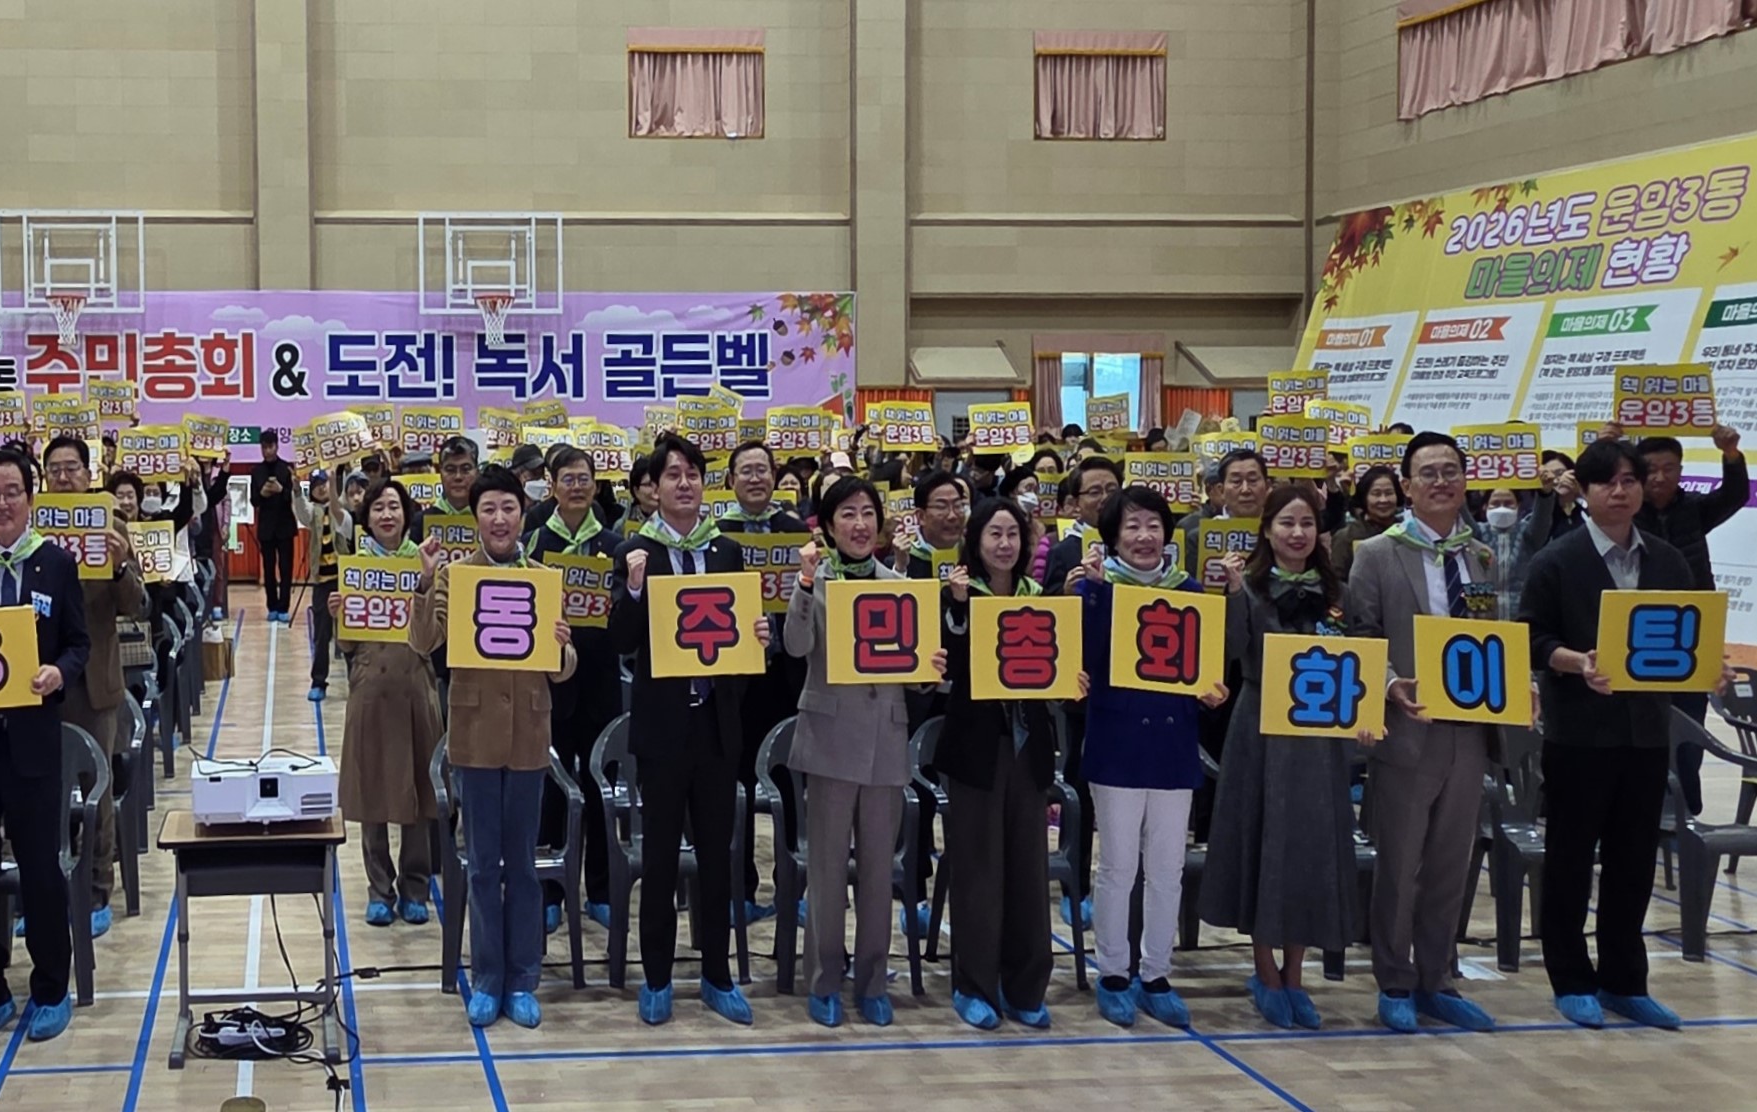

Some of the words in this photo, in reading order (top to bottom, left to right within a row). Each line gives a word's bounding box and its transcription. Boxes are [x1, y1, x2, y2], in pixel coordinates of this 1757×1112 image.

[1444, 191, 1597, 255] 2026년도
[1597, 165, 1750, 237] 운암3동
[1464, 242, 1604, 299] 마을의제
[1601, 231, 1691, 289] 현황
[1430, 325, 1468, 340] 마을의제
[1468, 319, 1493, 338] 02
[1560, 315, 1608, 333] 마을의제
[1608, 308, 1638, 332] 03
[1358, 329, 1375, 346] 01
[26, 331, 255, 400] 주민총회
[272, 343, 309, 397] &
[324, 331, 455, 398] 도전!
[474, 332, 584, 398] 독서
[603, 332, 770, 398] 골든벨
[1620, 375, 1640, 394] 책
[1643, 376, 1678, 395] 읽는
[1682, 375, 1710, 394] 마을
[1347, 409, 1368, 424] 마을
[1618, 398, 1715, 428] 운암3동
[228, 428, 251, 443] 장소
[768, 430, 822, 452] 운암3동
[884, 424, 935, 445] 운암3동
[974, 424, 1031, 447] 운암3동
[1277, 426, 1301, 440] 읽는
[1303, 427, 1326, 442] 마을
[1473, 434, 1502, 451] 읽는
[1507, 433, 1537, 450] 마을
[122, 452, 181, 475] 운암3동
[1261, 445, 1327, 468] 운암3동
[1170, 461, 1194, 477] 마을
[36, 506, 70, 529] 읽는
[73, 506, 107, 529] 마을
[147, 530, 170, 547] 마을
[447, 525, 476, 544] 읽는
[1206, 531, 1224, 551] 책
[1226, 531, 1258, 552] 읽는
[344, 569, 360, 591] 책
[364, 570, 398, 592] 읽는
[566, 566, 600, 587] 읽는
[474, 579, 538, 660] 동
[675, 586, 739, 666] 주
[853, 593, 919, 673] 민
[1136, 598, 1202, 686] 회
[1625, 603, 1701, 682] 팅
[995, 606, 1059, 690] 총
[1442, 633, 1507, 714] 이
[1288, 645, 1367, 729] 화
